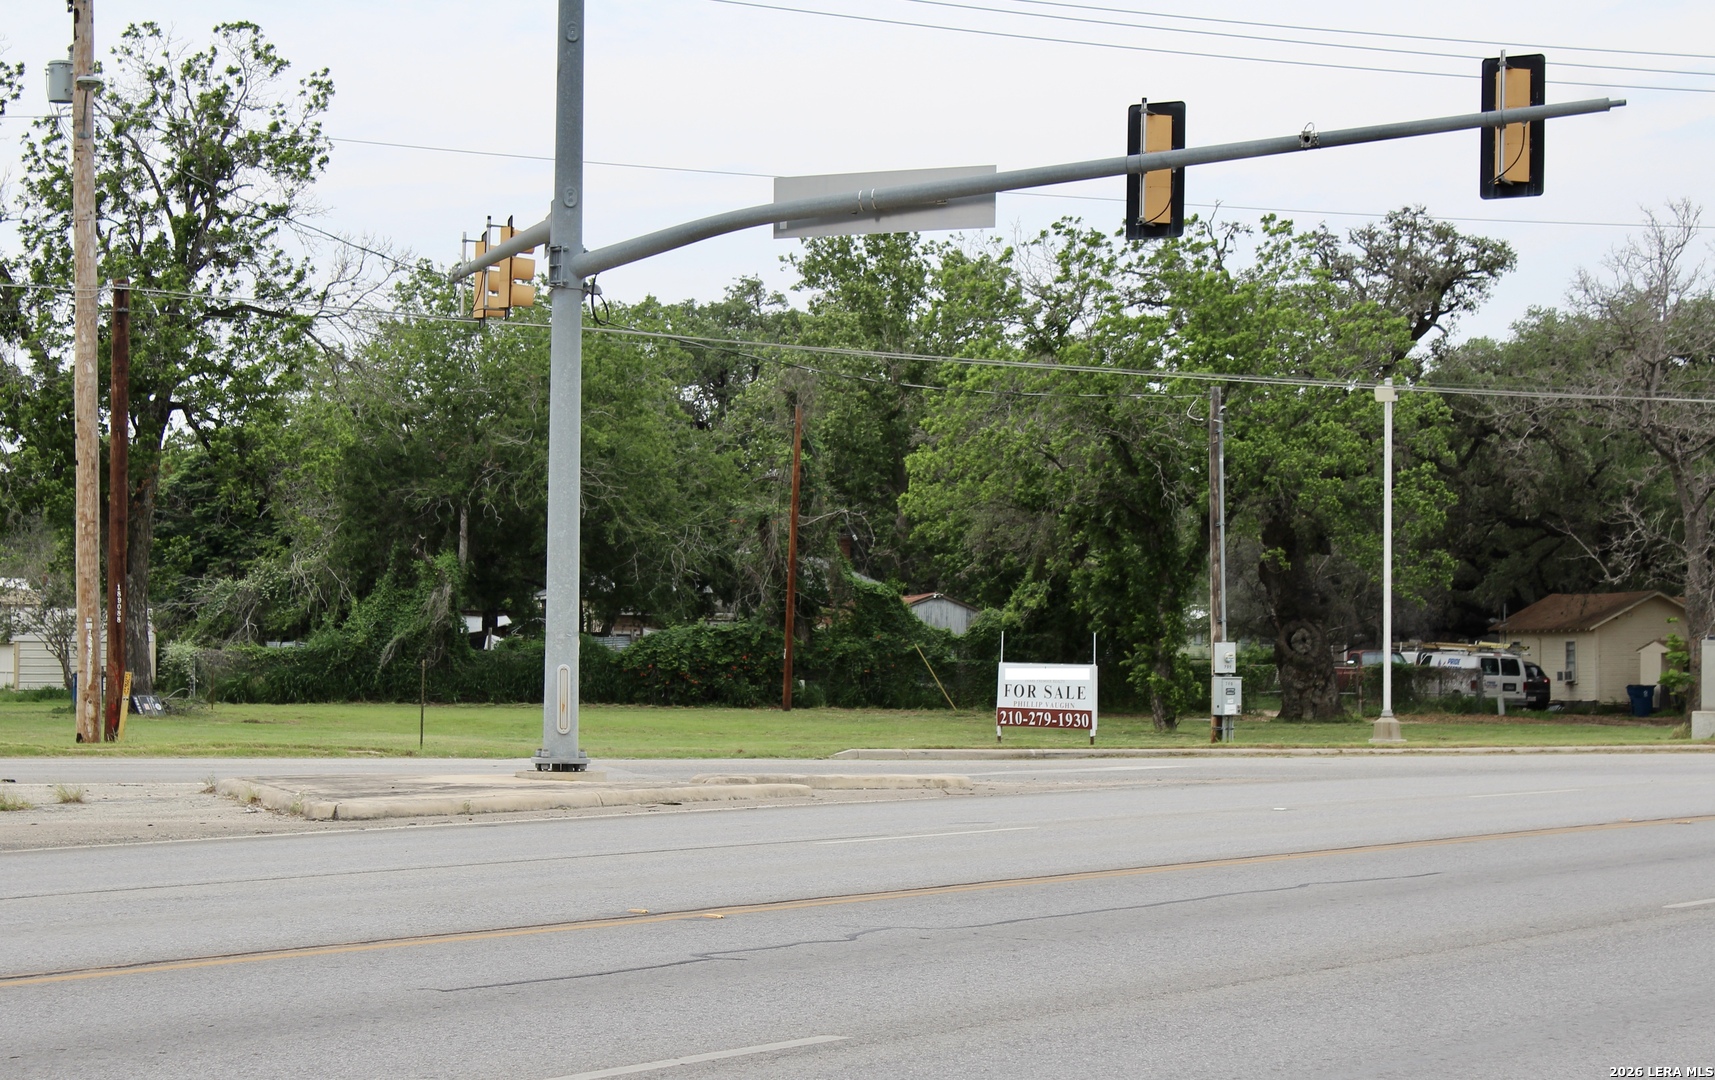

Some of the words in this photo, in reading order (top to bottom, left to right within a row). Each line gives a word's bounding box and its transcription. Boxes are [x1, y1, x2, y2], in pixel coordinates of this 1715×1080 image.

[1004, 684, 1036, 698] FOR
[1044, 685, 1086, 700] SALE
[999, 710, 1089, 728] 210-279-1930
